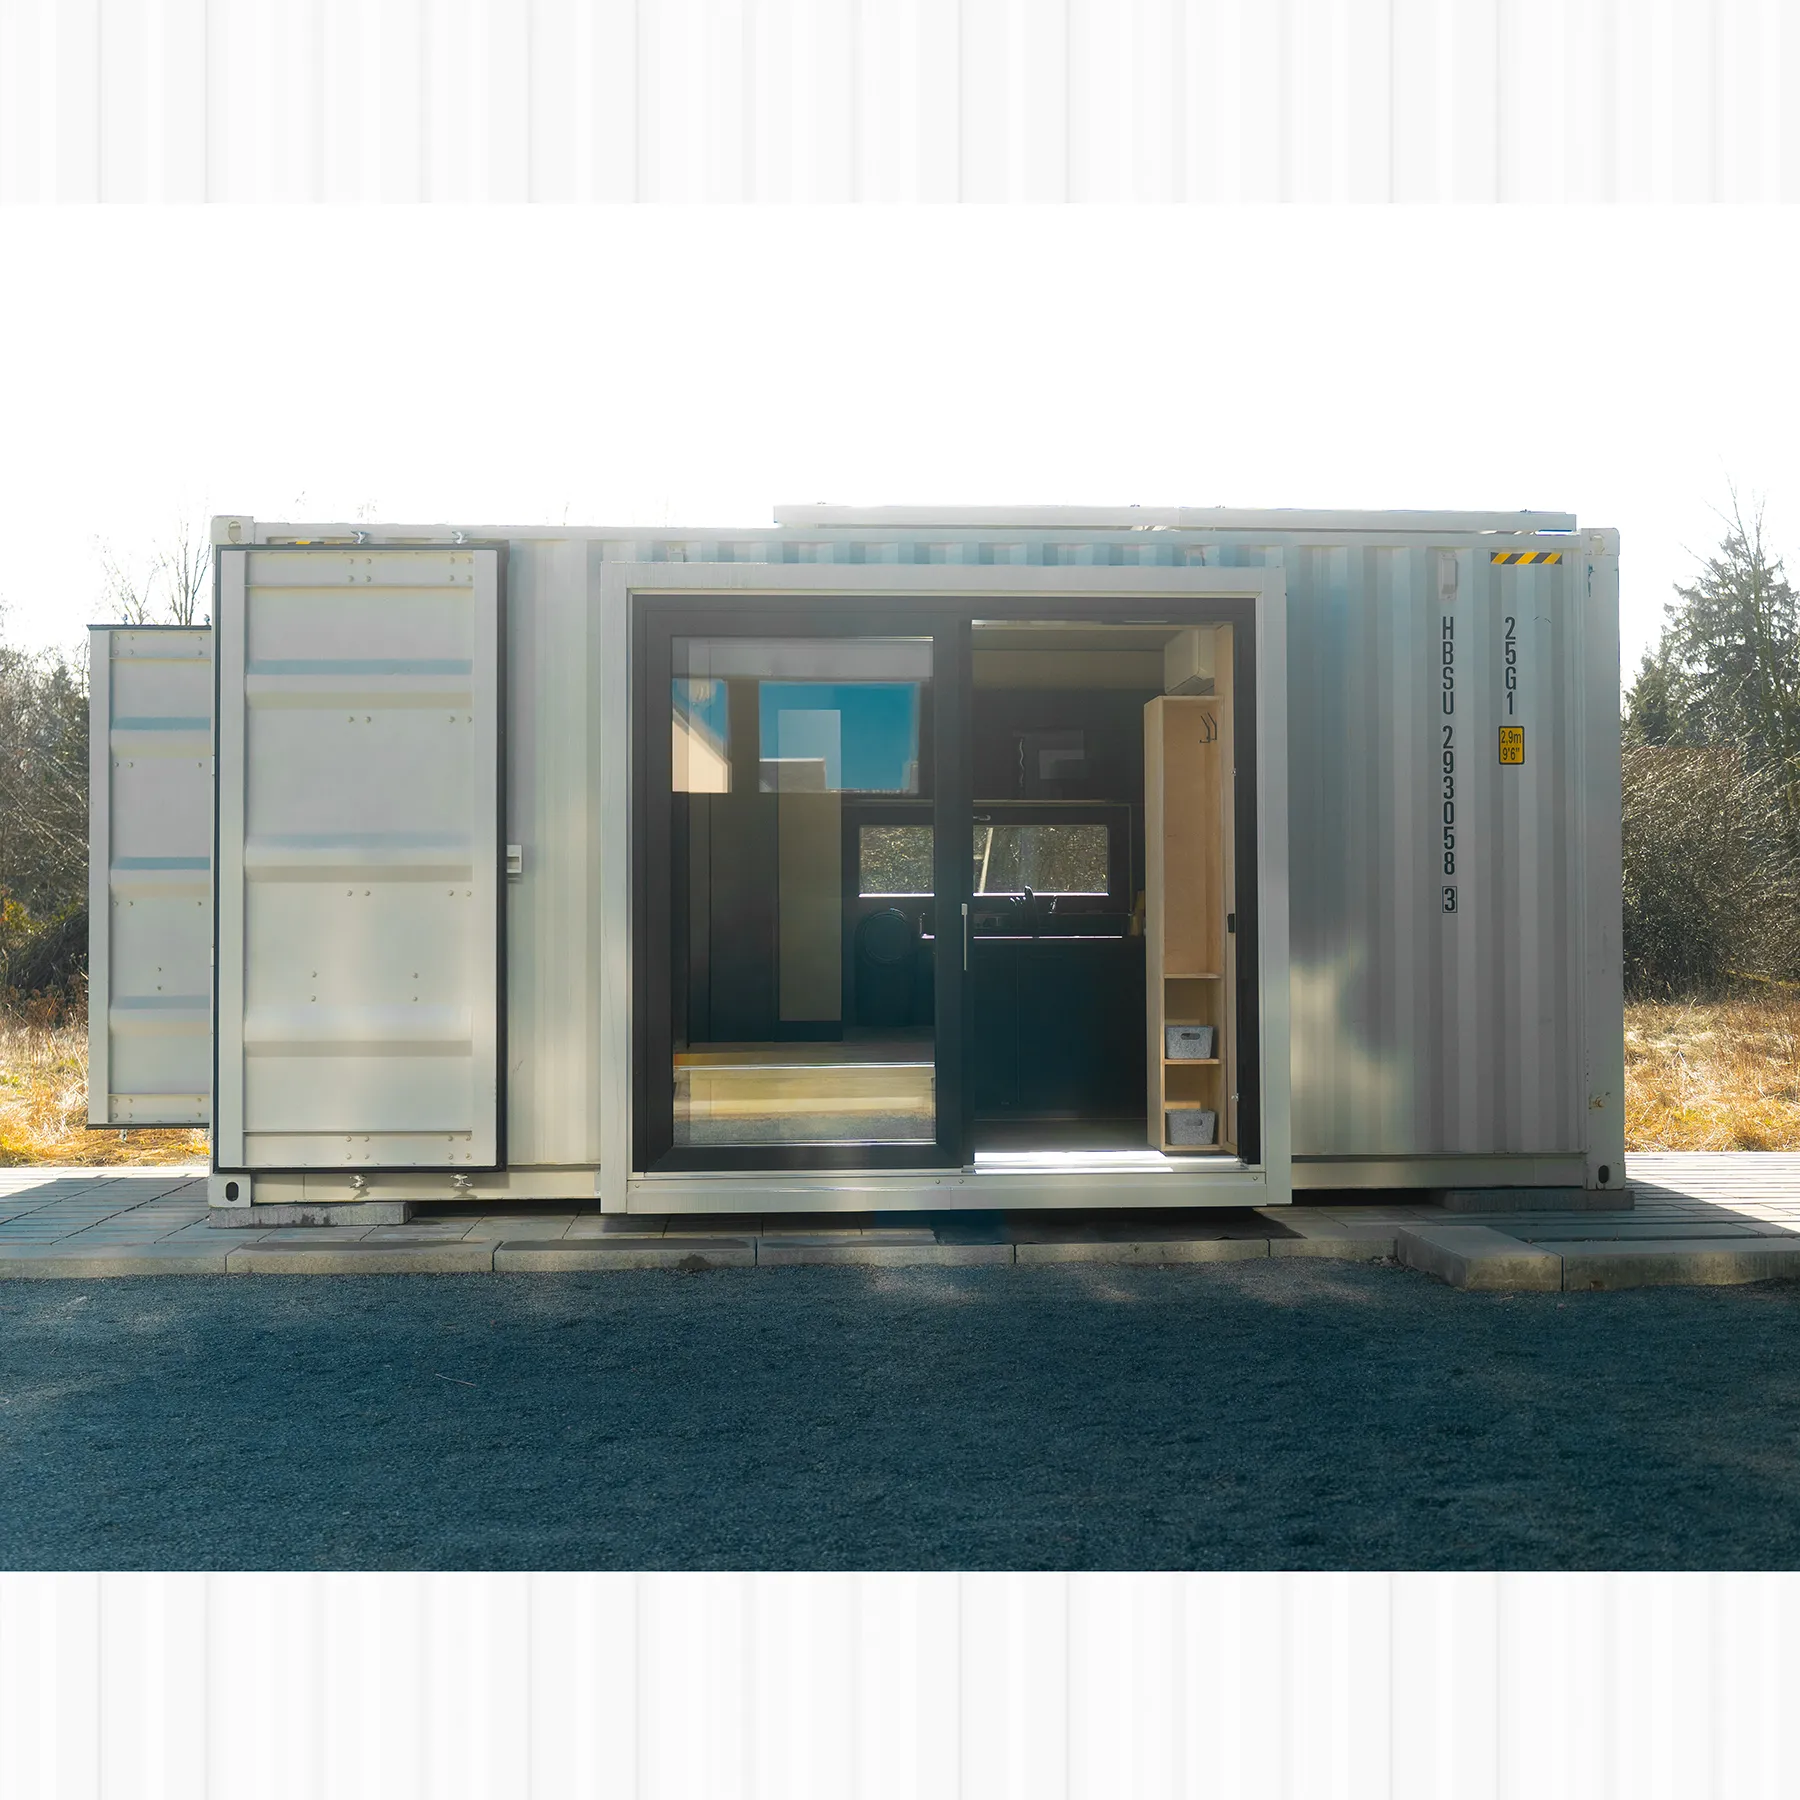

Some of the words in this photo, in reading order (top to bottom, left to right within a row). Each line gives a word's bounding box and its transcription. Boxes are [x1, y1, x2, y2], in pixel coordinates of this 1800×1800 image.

[1442, 616, 1454, 715] HBSU
[1504, 616, 1517, 715] 25G1
[1442, 725, 1455, 875] 293058
[1444, 887, 1456, 912] 3
